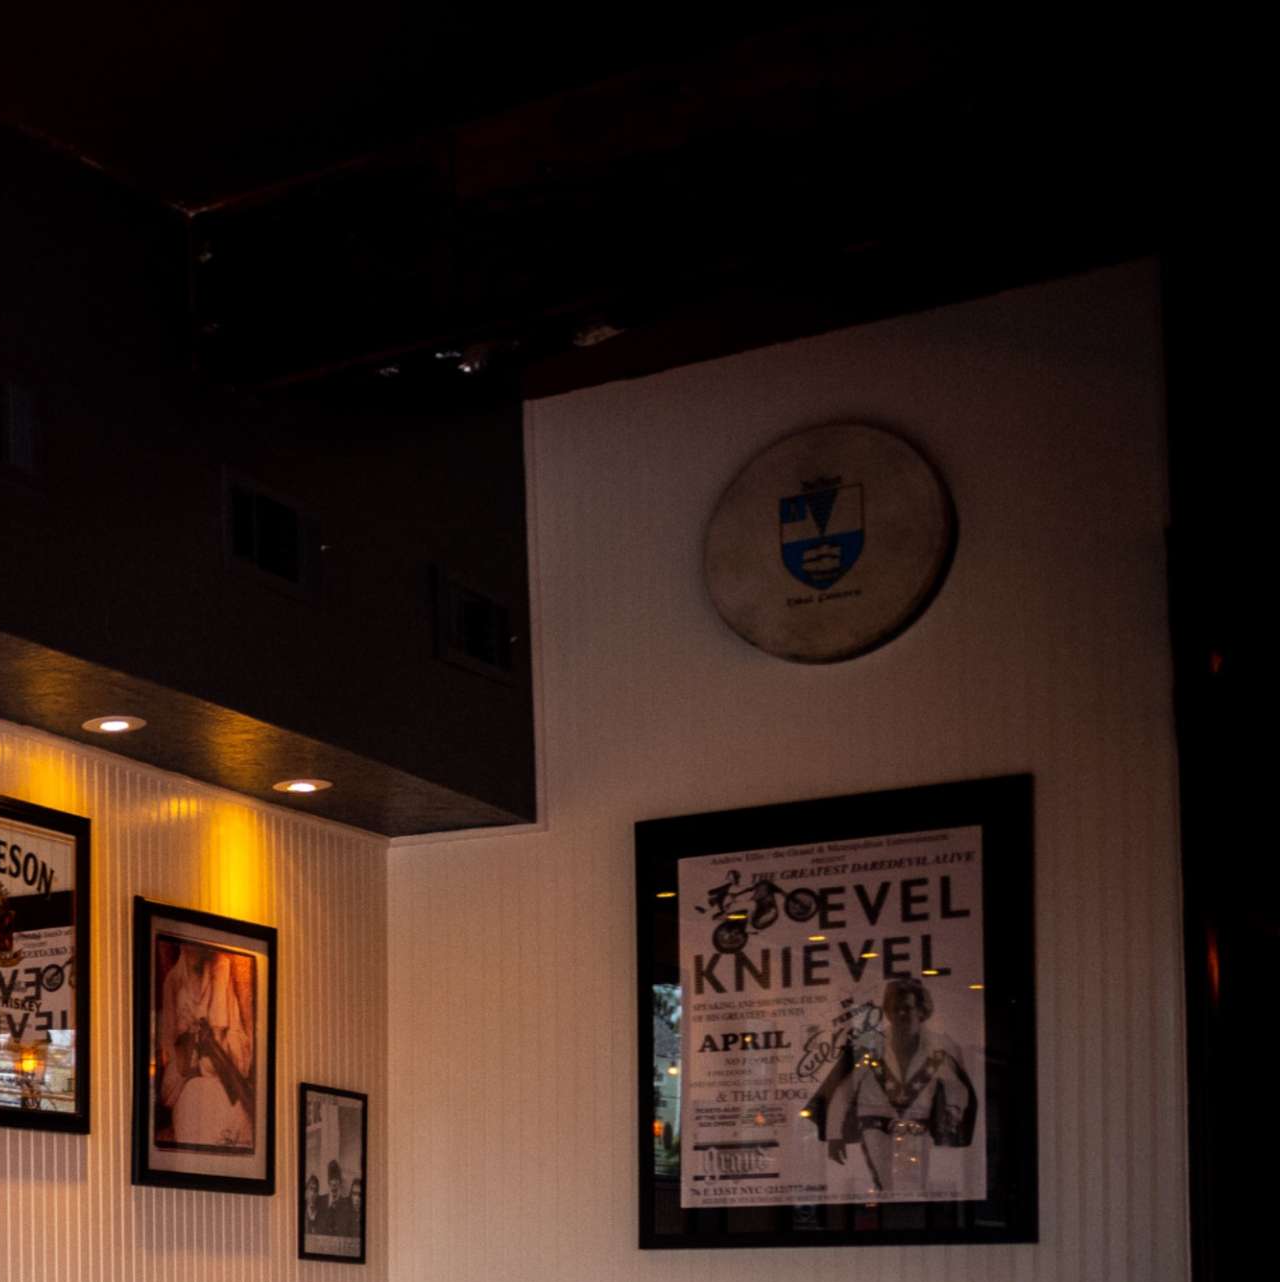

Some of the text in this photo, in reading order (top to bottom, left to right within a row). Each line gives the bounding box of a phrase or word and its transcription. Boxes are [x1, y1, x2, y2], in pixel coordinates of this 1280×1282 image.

[750, 850, 976, 884] THE GREATEST DAREDEVIL ALIVE
[818, 875, 971, 931] EVEL
[693, 934, 952, 996] KNIEVEL
[698, 1030, 792, 1053] APRIL
[732, 1089, 770, 1102] THAT
[774, 1088, 808, 1101] DOG
